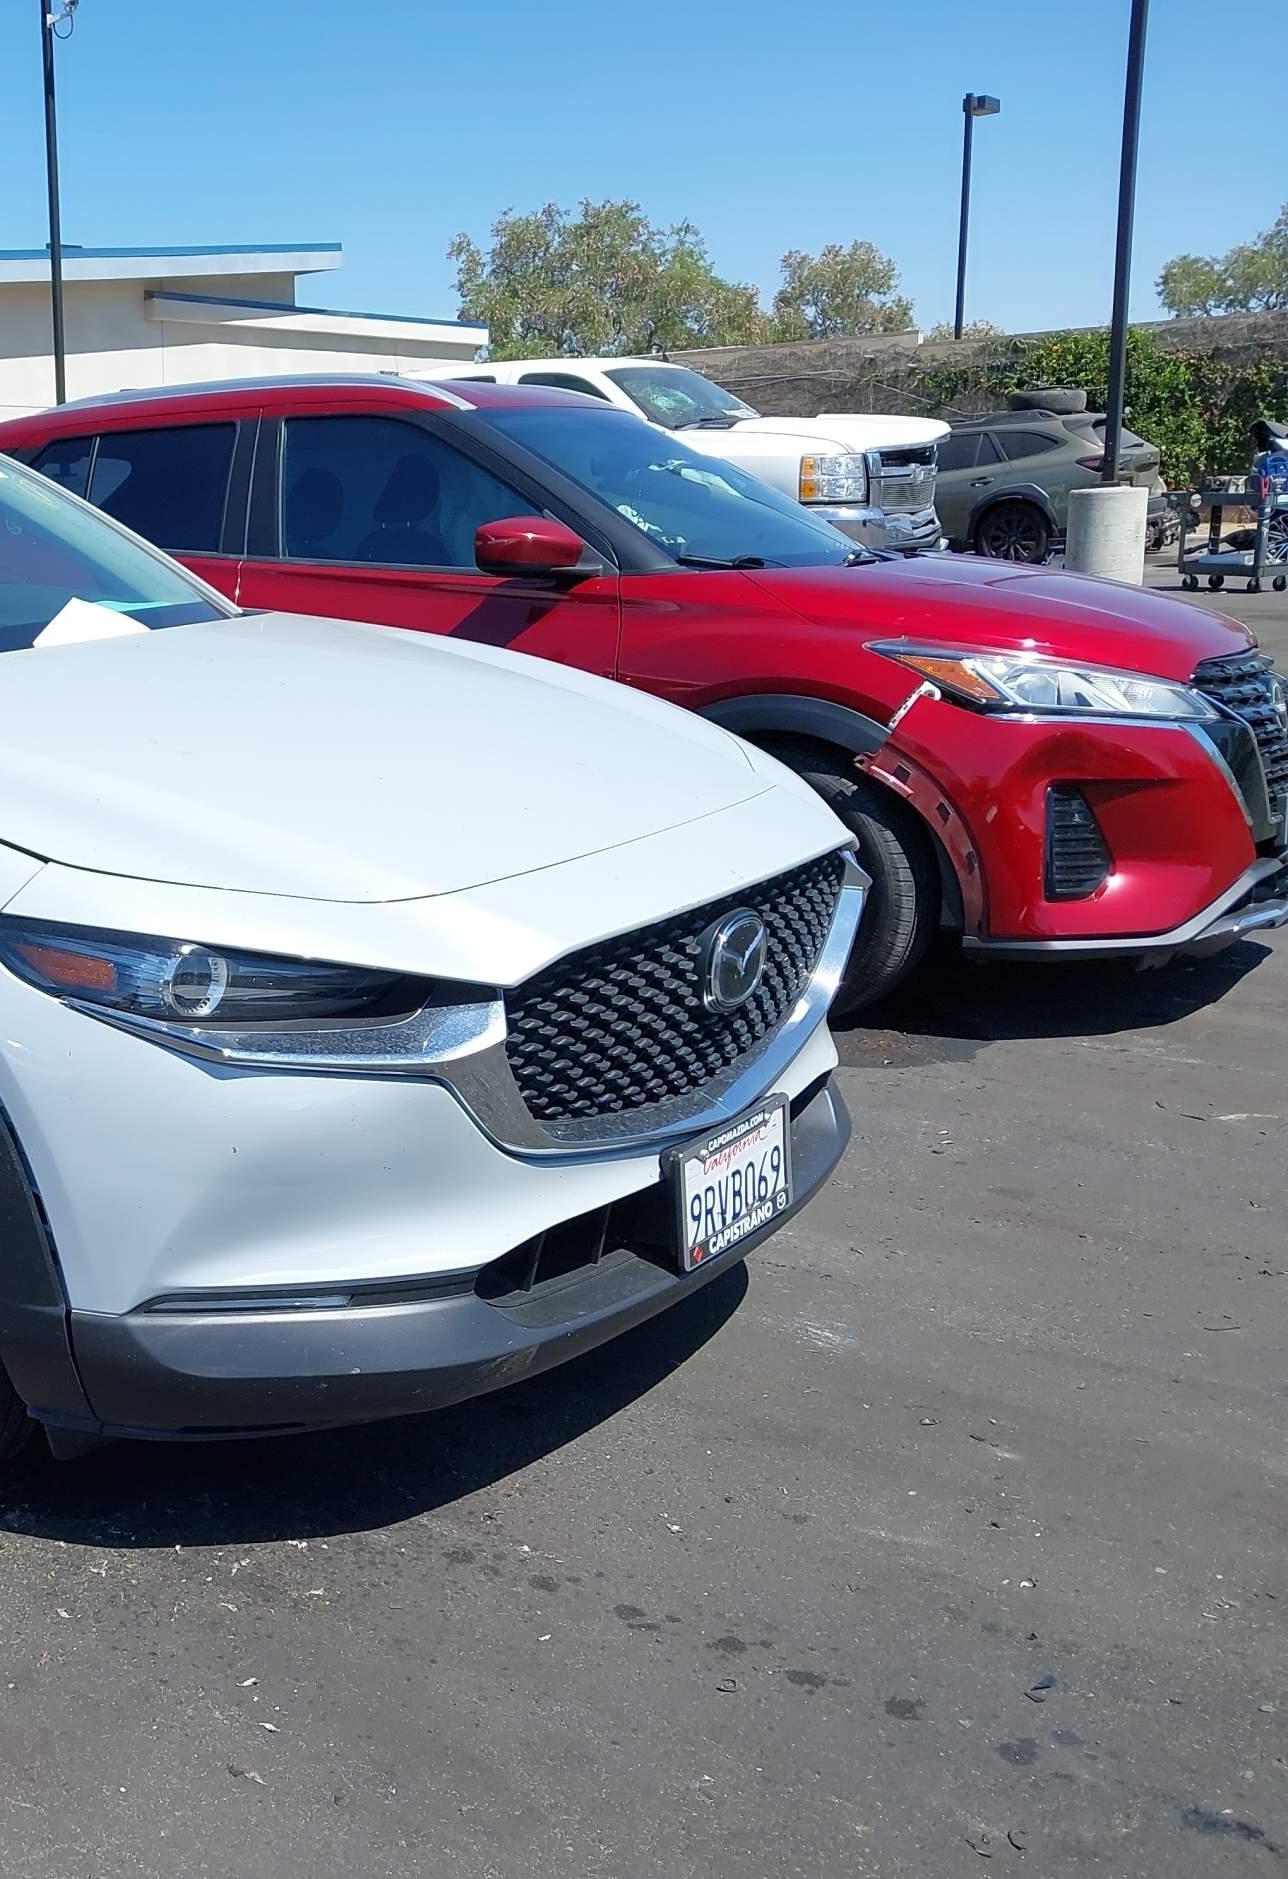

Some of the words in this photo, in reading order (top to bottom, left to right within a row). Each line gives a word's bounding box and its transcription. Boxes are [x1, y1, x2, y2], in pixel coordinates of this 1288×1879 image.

[708, 1112, 764, 1152] CAPOMAZDA.COM
[691, 1145, 781, 1246] 9RVB069
[709, 1203, 773, 1254] CAPISTRANO
